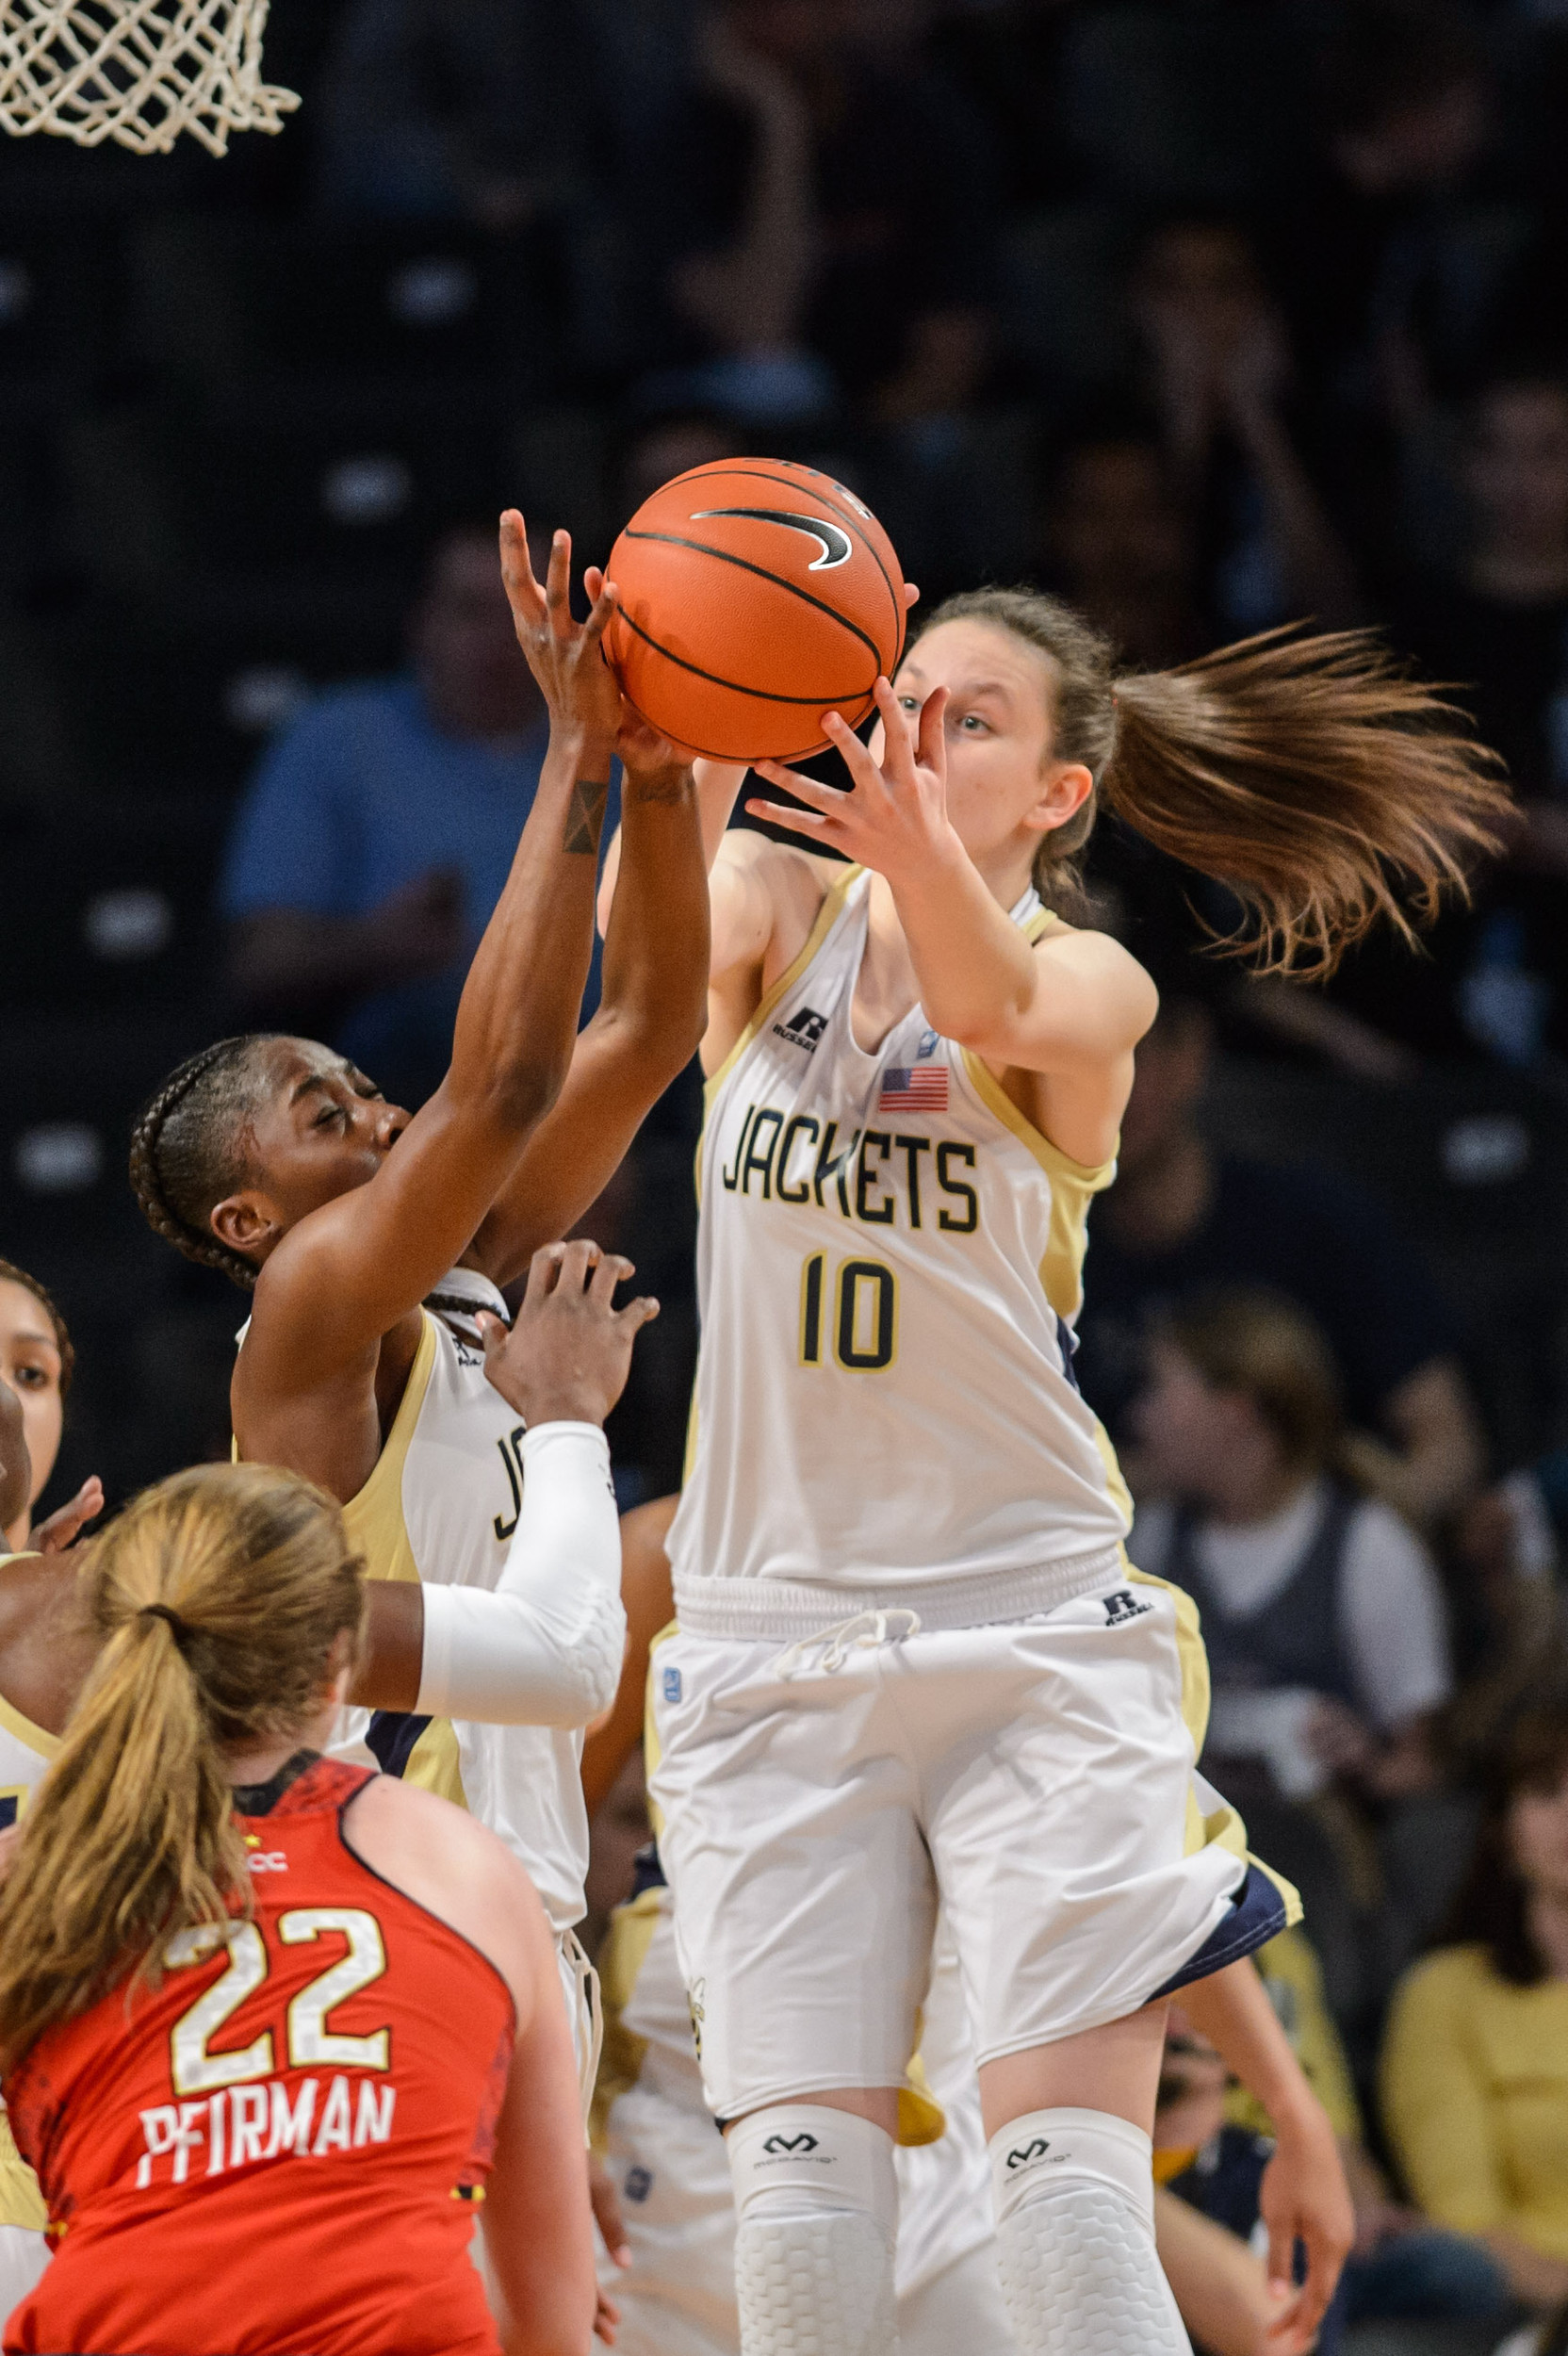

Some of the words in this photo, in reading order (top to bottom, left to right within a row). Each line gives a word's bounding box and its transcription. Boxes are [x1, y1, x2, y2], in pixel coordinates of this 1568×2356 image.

[723, 1104, 979, 1234] JACKETS
[798, 1250, 899, 1373] 10
[163, 1908, 391, 2096] 22
[137, 2075, 396, 2188] PFIRMAN
